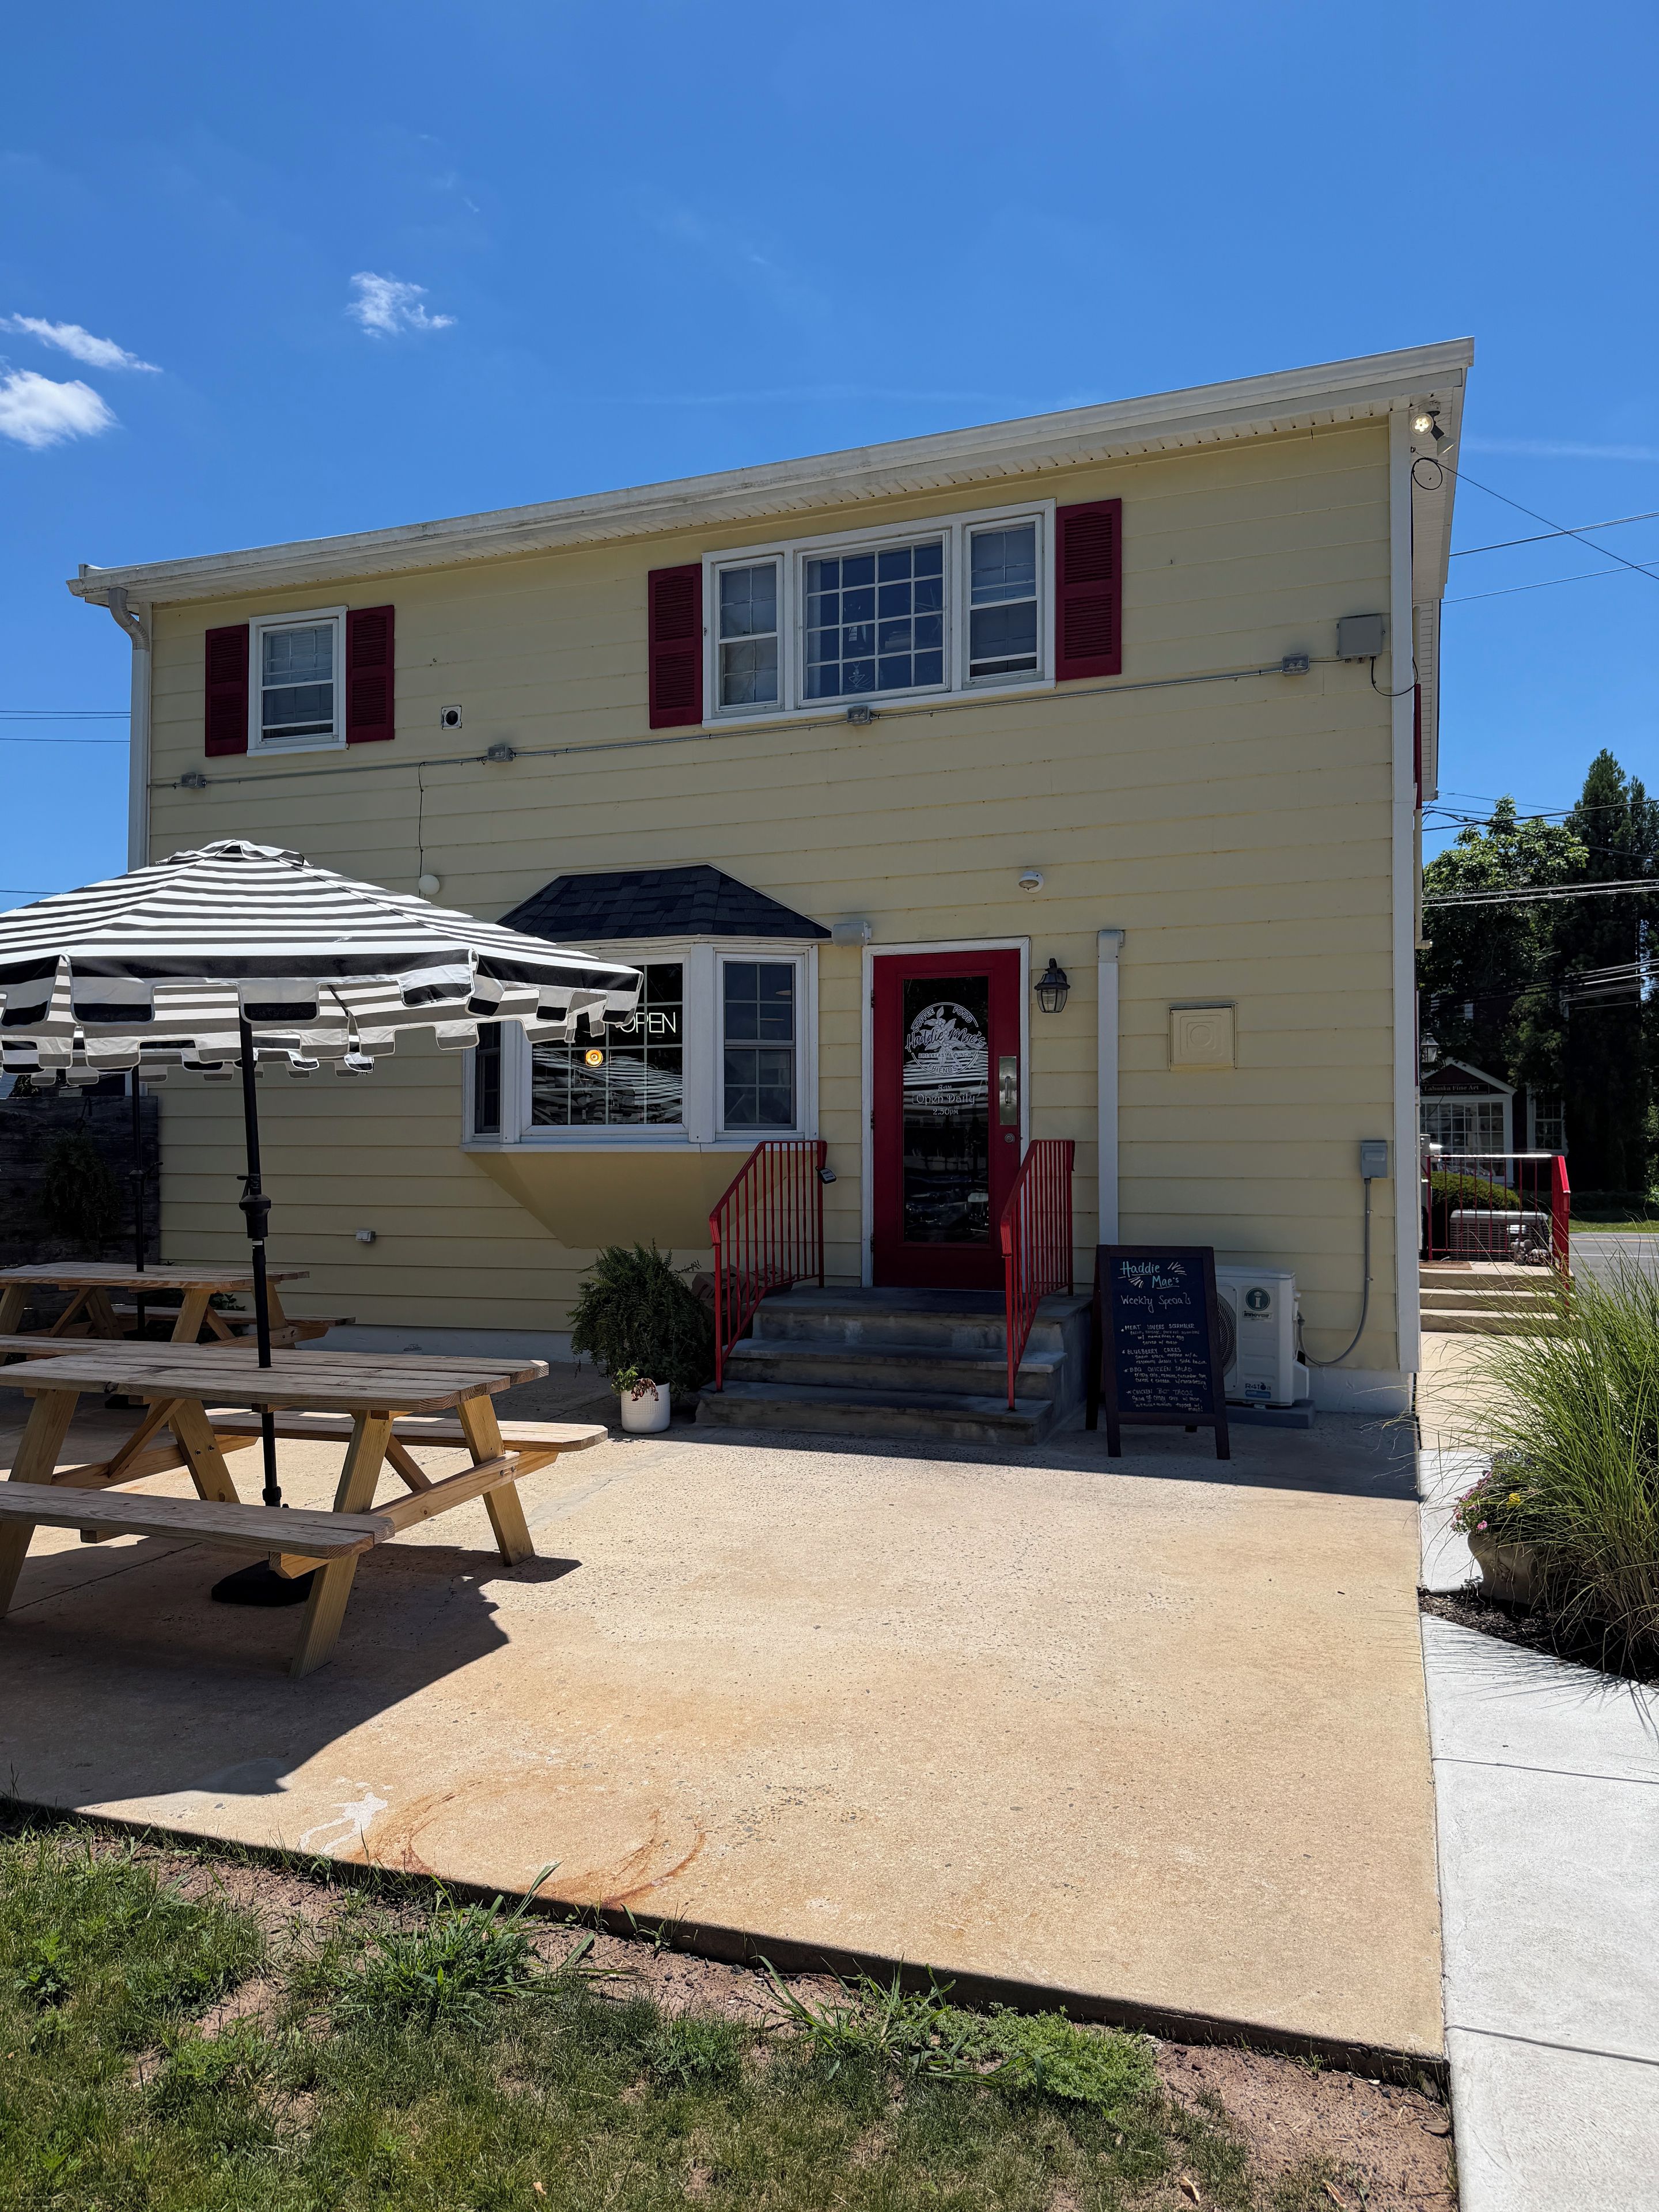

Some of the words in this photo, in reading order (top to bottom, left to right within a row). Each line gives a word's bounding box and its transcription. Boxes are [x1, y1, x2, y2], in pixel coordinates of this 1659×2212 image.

[914, 1008, 935, 1033] COFFEE
[952, 1007, 973, 1024] FOOD
[905, 1030, 945, 1052] Haddie
[947, 1028, 987, 1047] Mae's
[927, 1063, 959, 1074] FRIENDS
[913, 1093, 944, 1105] Open
[946, 1093, 975, 1105] Daily
[1120, 1261, 1160, 1278] Haddie
[1152, 1275, 1180, 1289] Mae's
[1120, 1295, 1154, 1313] Weekly
[1158, 1292, 1192, 1309] Specials
